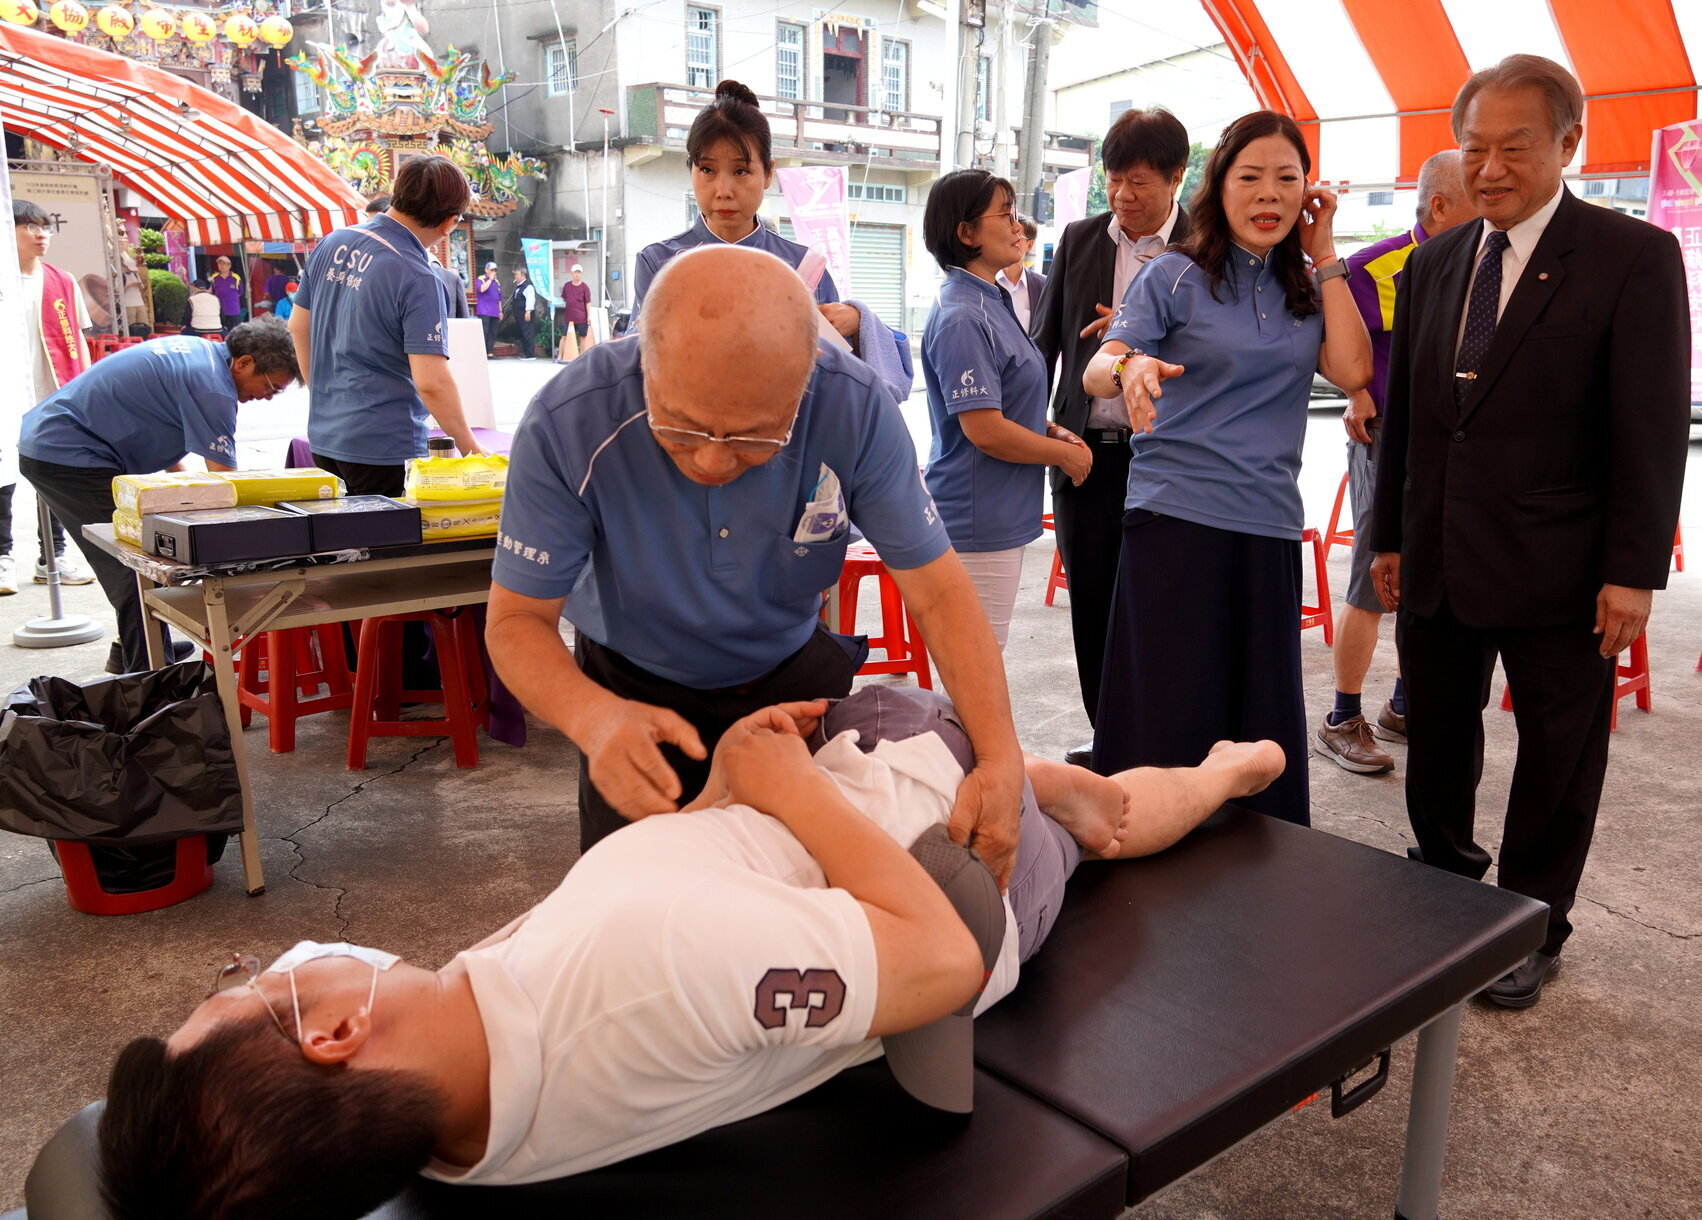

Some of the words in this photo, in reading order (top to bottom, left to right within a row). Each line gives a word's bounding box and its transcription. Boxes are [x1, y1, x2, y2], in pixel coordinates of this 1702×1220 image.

[15, 4, 34, 21] 大
[333, 245, 373, 273] CSU
[326, 267, 362, 290] 養身保健
[952, 386, 988, 400] 正修科大
[754, 968, 846, 1030] 3
